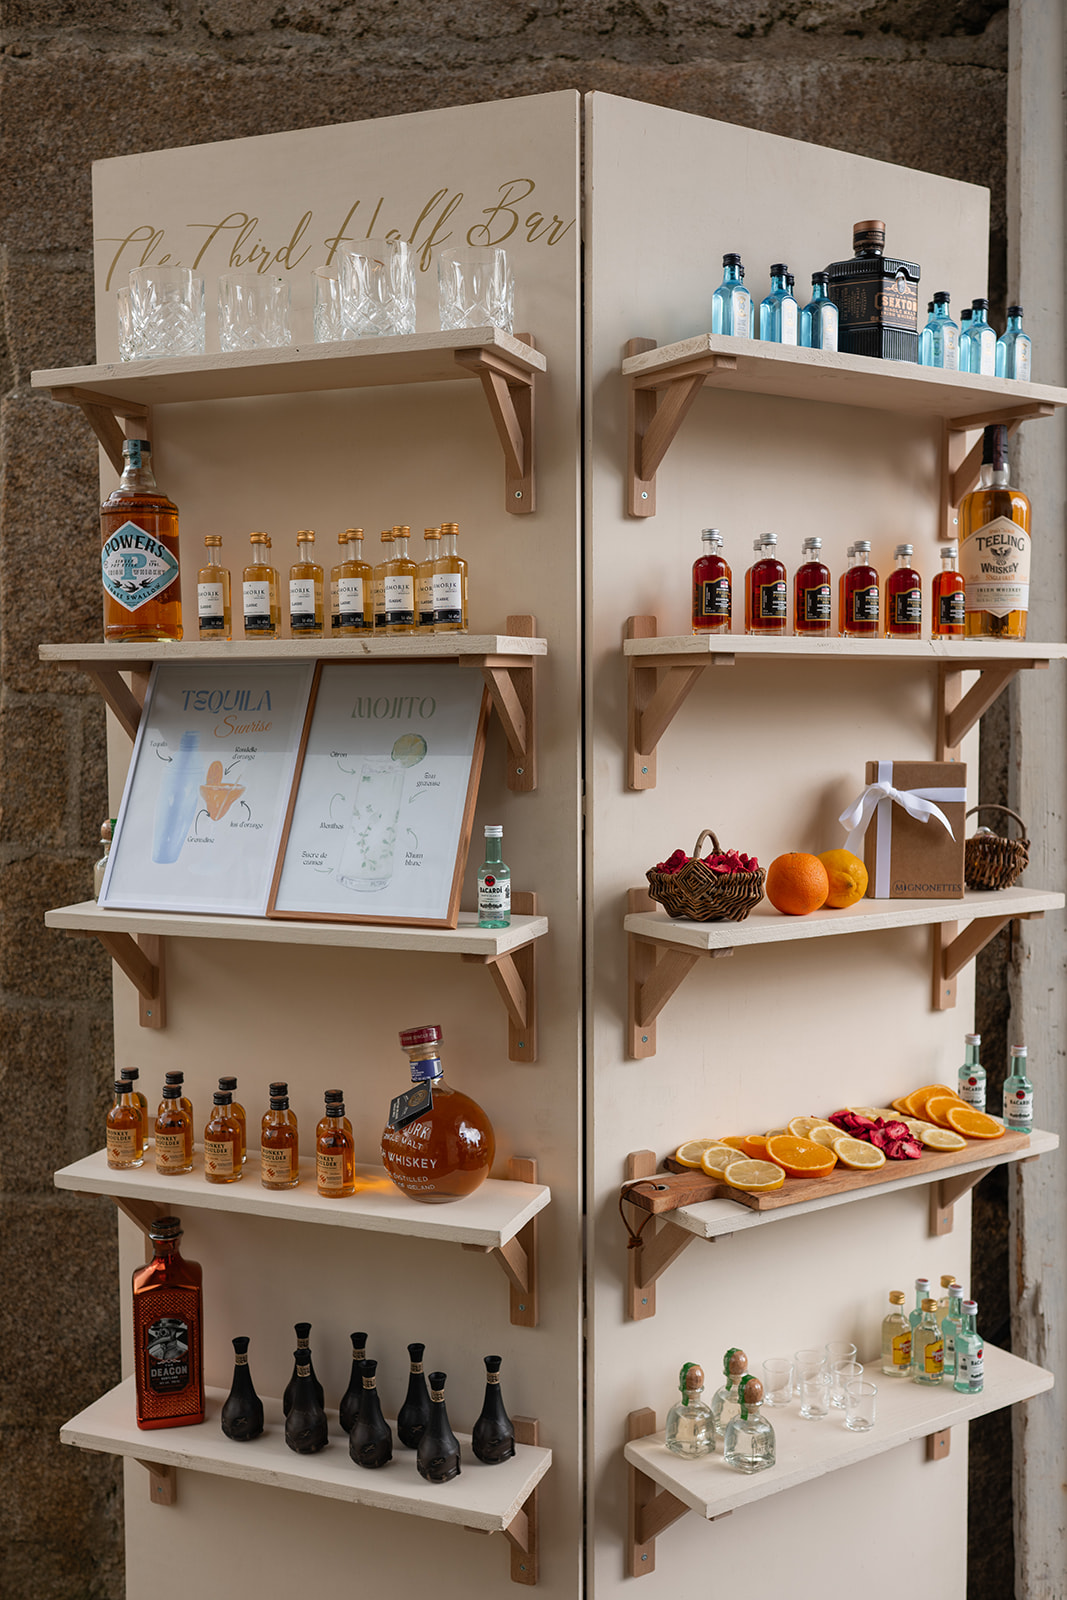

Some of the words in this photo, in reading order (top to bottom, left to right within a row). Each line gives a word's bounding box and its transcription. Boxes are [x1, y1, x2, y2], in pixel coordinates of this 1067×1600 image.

[186, 211, 313, 274] Third
[466, 178, 577, 247] Bar
[975, 534, 1025, 551] TEELING
[981, 562, 1019, 574] WHISKEY
[182, 690, 272, 714] TEQUILA
[351, 697, 437, 719] MOJITO
[213, 715, 272, 738] Sunrise
[301, 851, 319, 859] Sucre
[320, 851, 328, 859] de
[893, 881, 962, 894] MIGNONETTES
[388, 1151, 438, 1169] WHISKEY
[151, 1365, 187, 1378] DEACON
